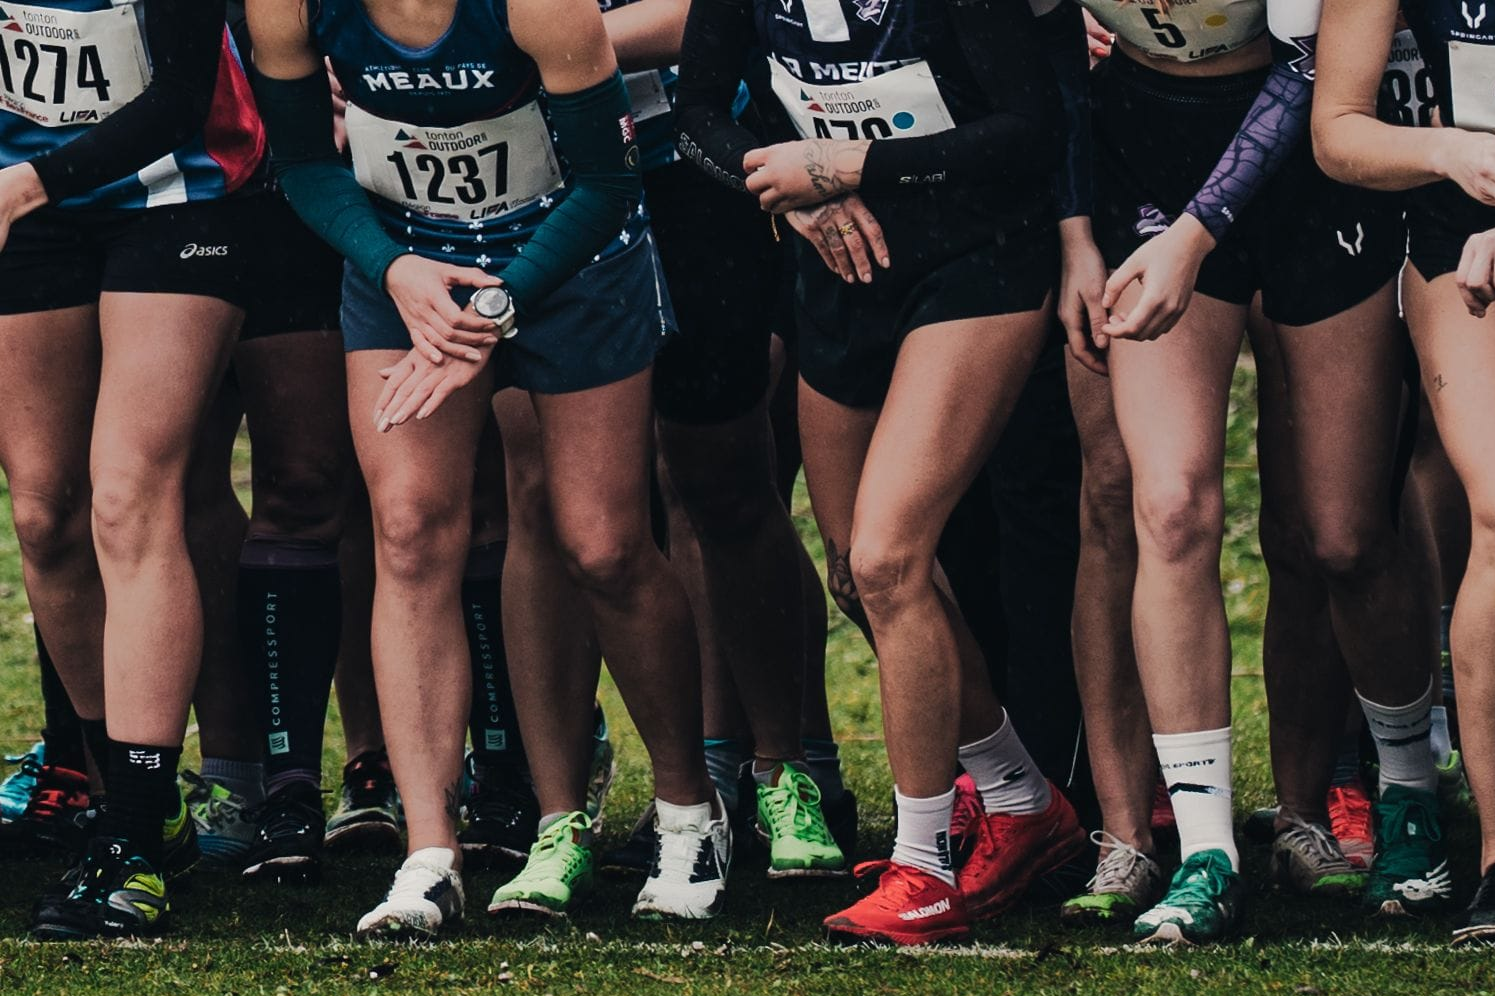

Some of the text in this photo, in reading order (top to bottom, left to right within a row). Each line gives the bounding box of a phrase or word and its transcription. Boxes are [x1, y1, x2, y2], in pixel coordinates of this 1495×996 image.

[23, 11, 57, 24] tonton
[26, 23, 74, 40] OUTDOOR
[0, 33, 110, 104] 1274
[362, 70, 495, 91] MEAUX
[820, 91, 854, 101] tonton
[824, 100, 875, 114] OUTDOOR
[60, 110, 98, 123] LIFA
[425, 131, 463, 140] tonton
[429, 135, 482, 151] OUTDOOR
[387, 141, 508, 204] 1237
[470, 202, 508, 219] LIFA
[266, 592, 281, 727] COMPRESSPORT
[472, 603, 499, 723] COMPRESSPORT
